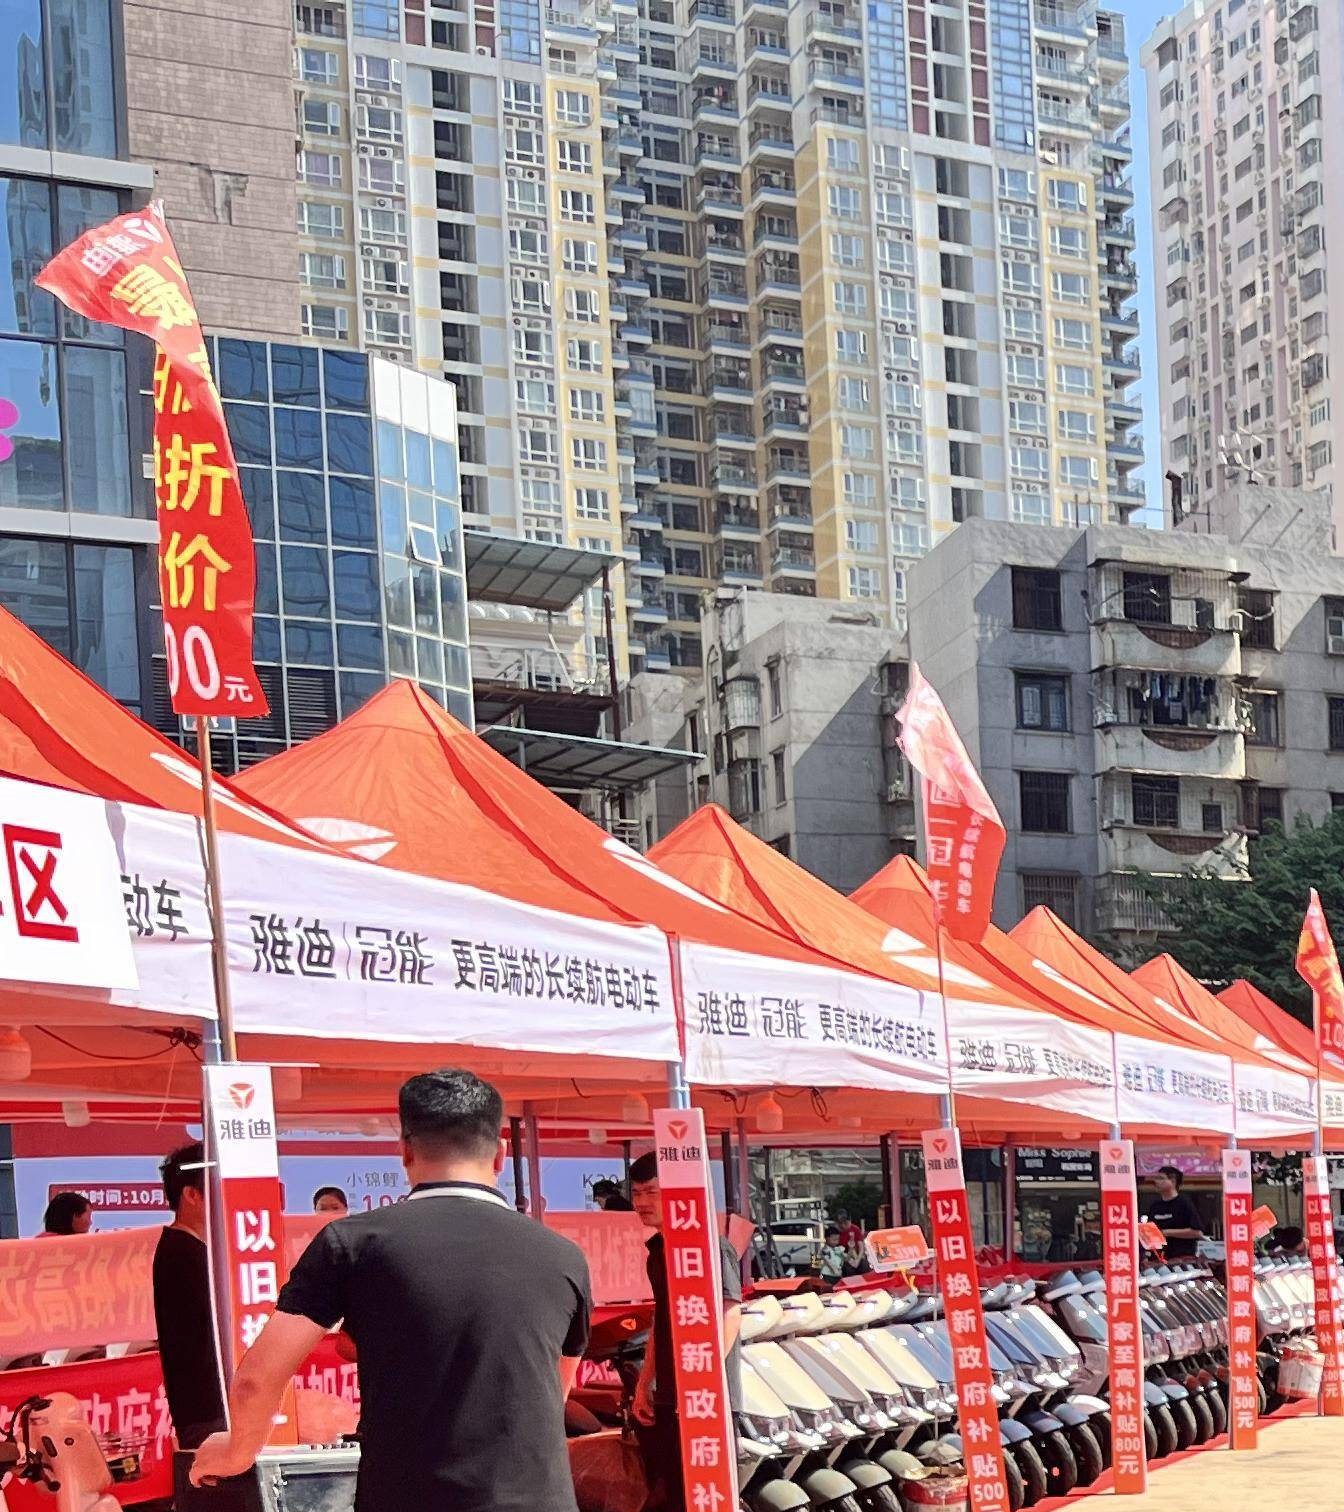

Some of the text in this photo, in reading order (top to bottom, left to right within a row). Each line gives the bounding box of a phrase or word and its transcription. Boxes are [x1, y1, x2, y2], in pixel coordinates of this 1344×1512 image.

[250, 914, 661, 1013] 雅迪 冠能 更高端的长续航电动车
[697, 990, 750, 1037] 雅迪
[761, 997, 809, 1040] 冠能
[219, 1119, 273, 1140] 雅迪
[660, 1146, 701, 1162] 雅迪
[1107, 1204, 1141, 1475] 以旧换新厂家至高补贴800元
